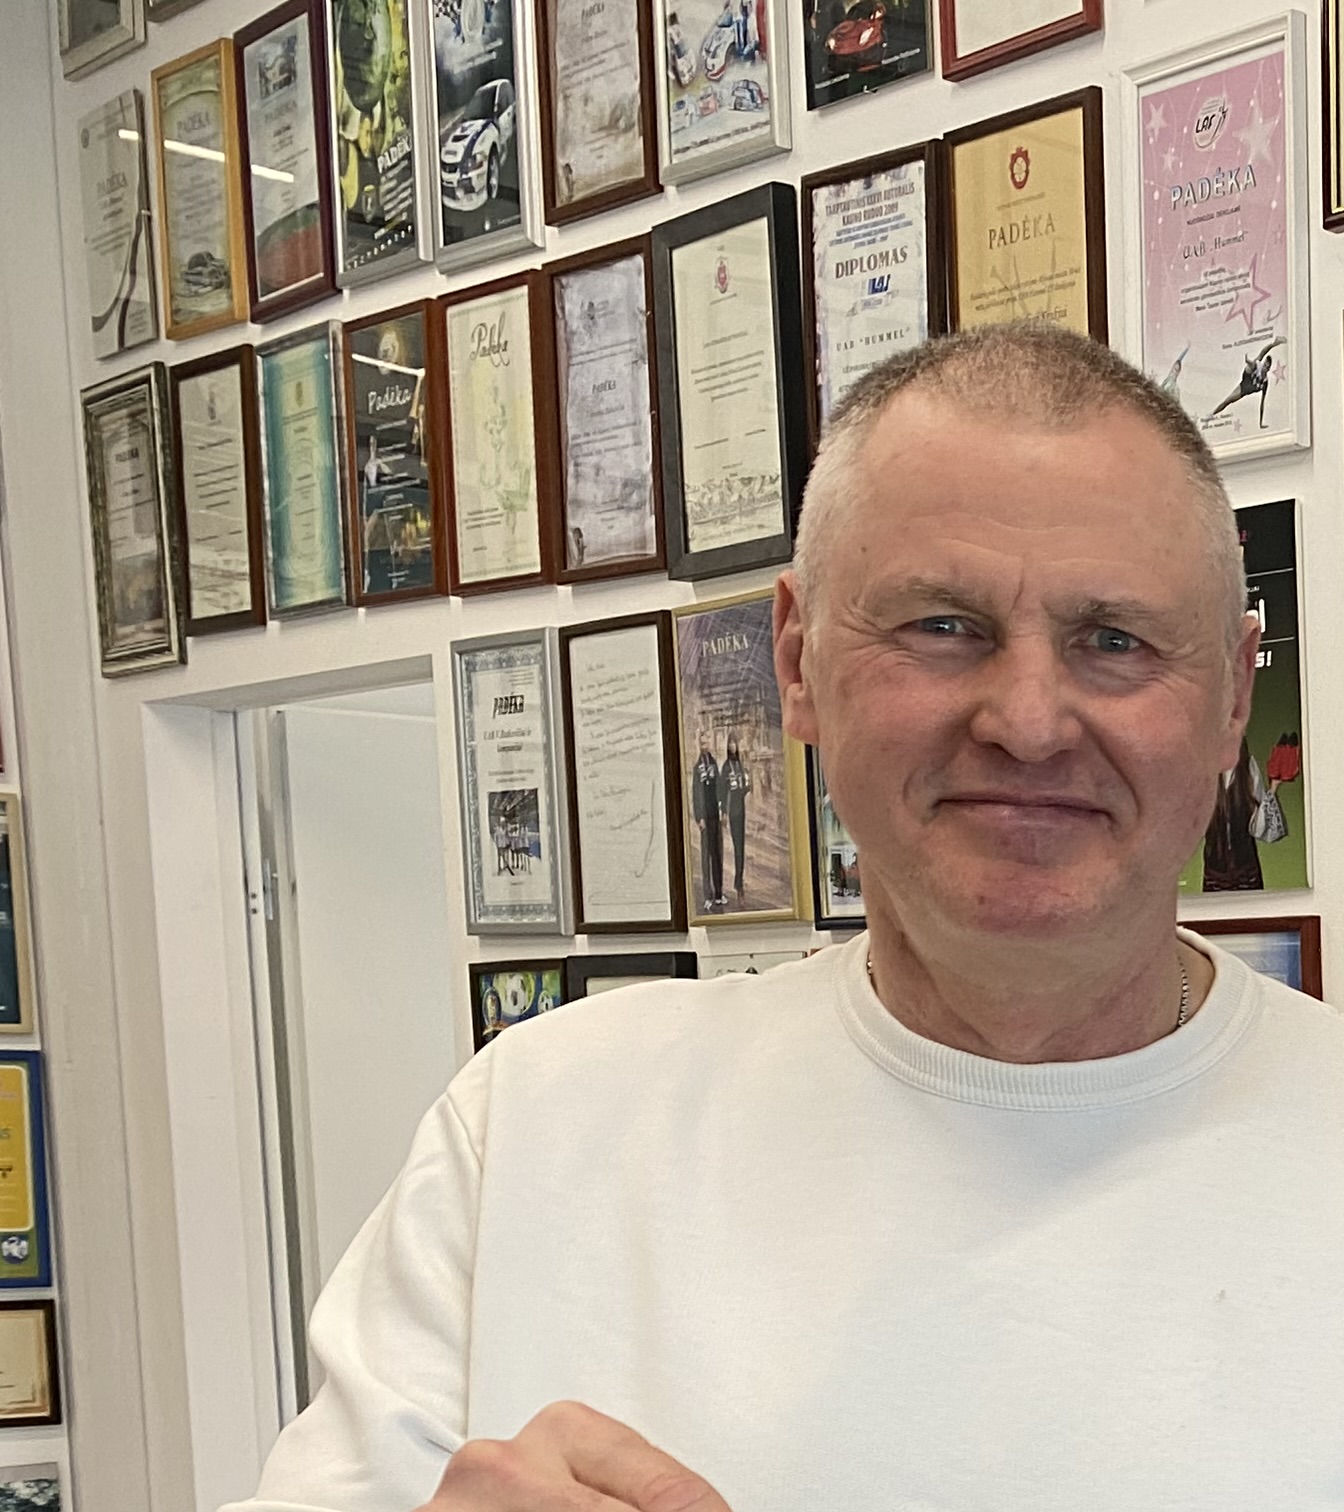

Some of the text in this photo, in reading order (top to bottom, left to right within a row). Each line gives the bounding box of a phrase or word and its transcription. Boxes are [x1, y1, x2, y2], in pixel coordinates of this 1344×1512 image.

[1170, 164, 1258, 211] PADĖKA
[988, 212, 1056, 250] PADĖKA
[835, 245, 908, 279] DIPLOMAS
[367, 384, 412, 415] Padėka
[702, 631, 749, 658] PADĖKA
